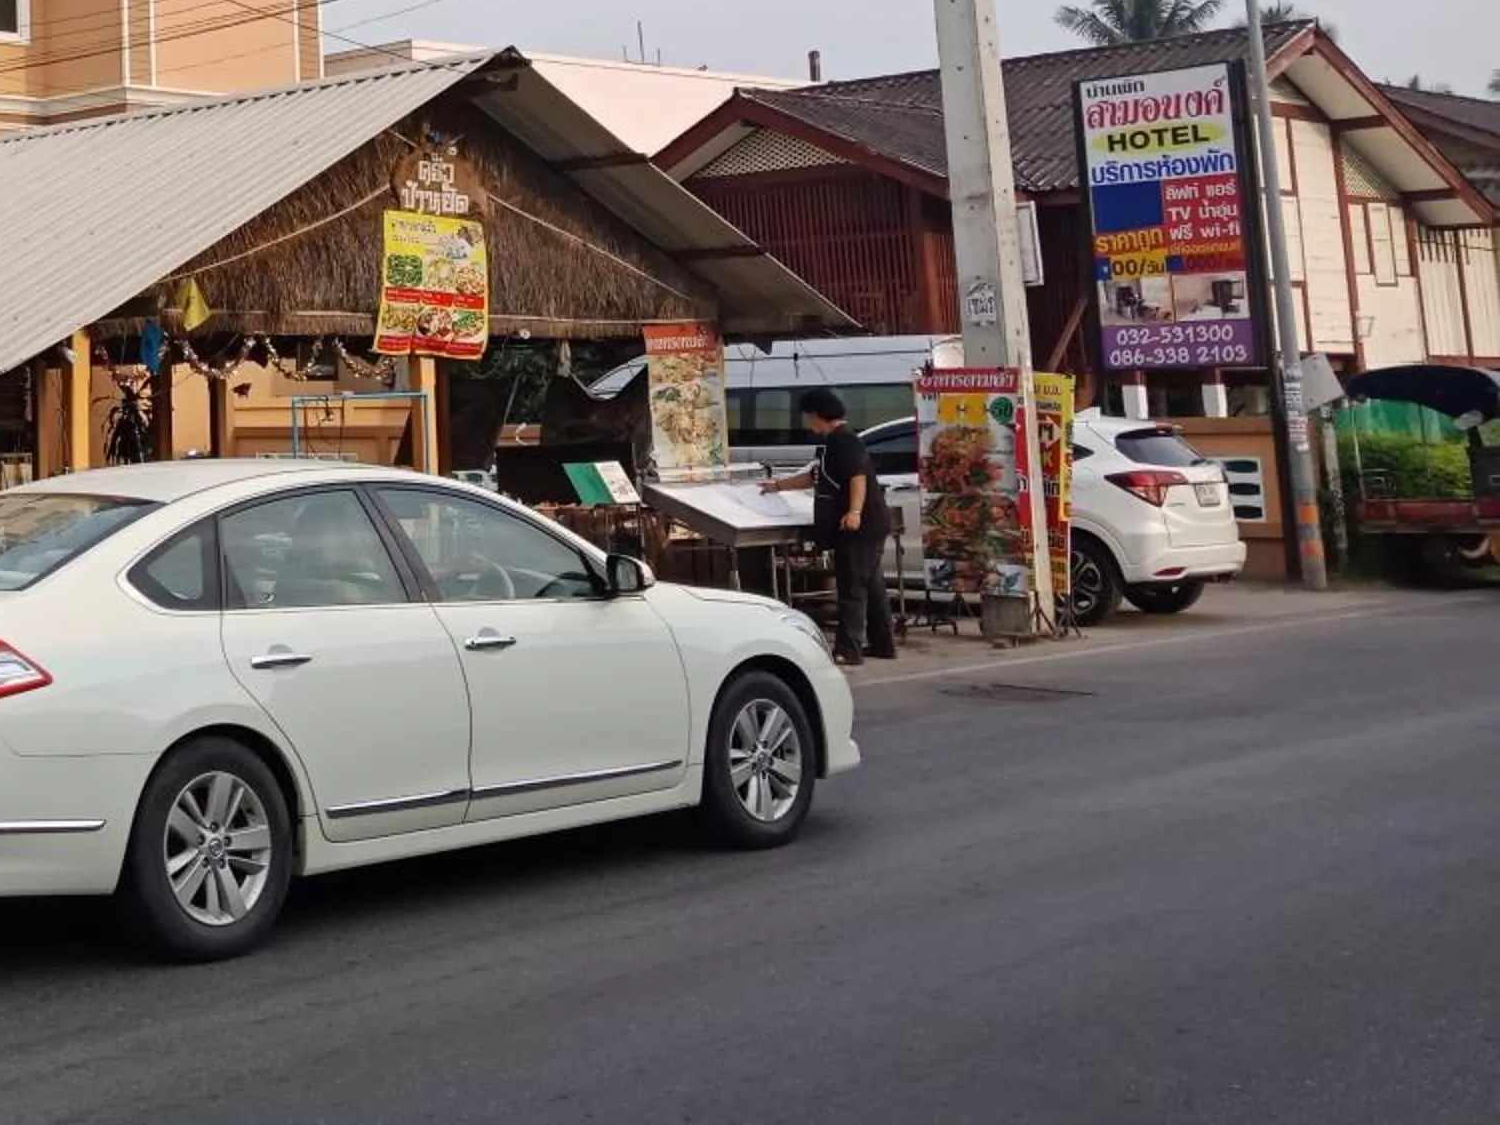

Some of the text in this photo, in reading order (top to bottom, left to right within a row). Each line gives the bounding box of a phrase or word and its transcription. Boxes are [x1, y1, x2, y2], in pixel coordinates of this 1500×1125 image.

[1086, 79, 1145, 99] บ้านพัก
[1107, 125, 1211, 152] HOTEL
[1092, 149, 1236, 183] บริการห้องพัก
[1167, 206, 1191, 221] TV
[1095, 228, 1164, 254] ราคาถูก
[1169, 220, 1241, 241] ฟรี wi-fi
[1106, 257, 1165, 275] 00/วัน
[1116, 325, 1234, 346] 032-531300
[1109, 344, 1248, 367] 086-338 2103
